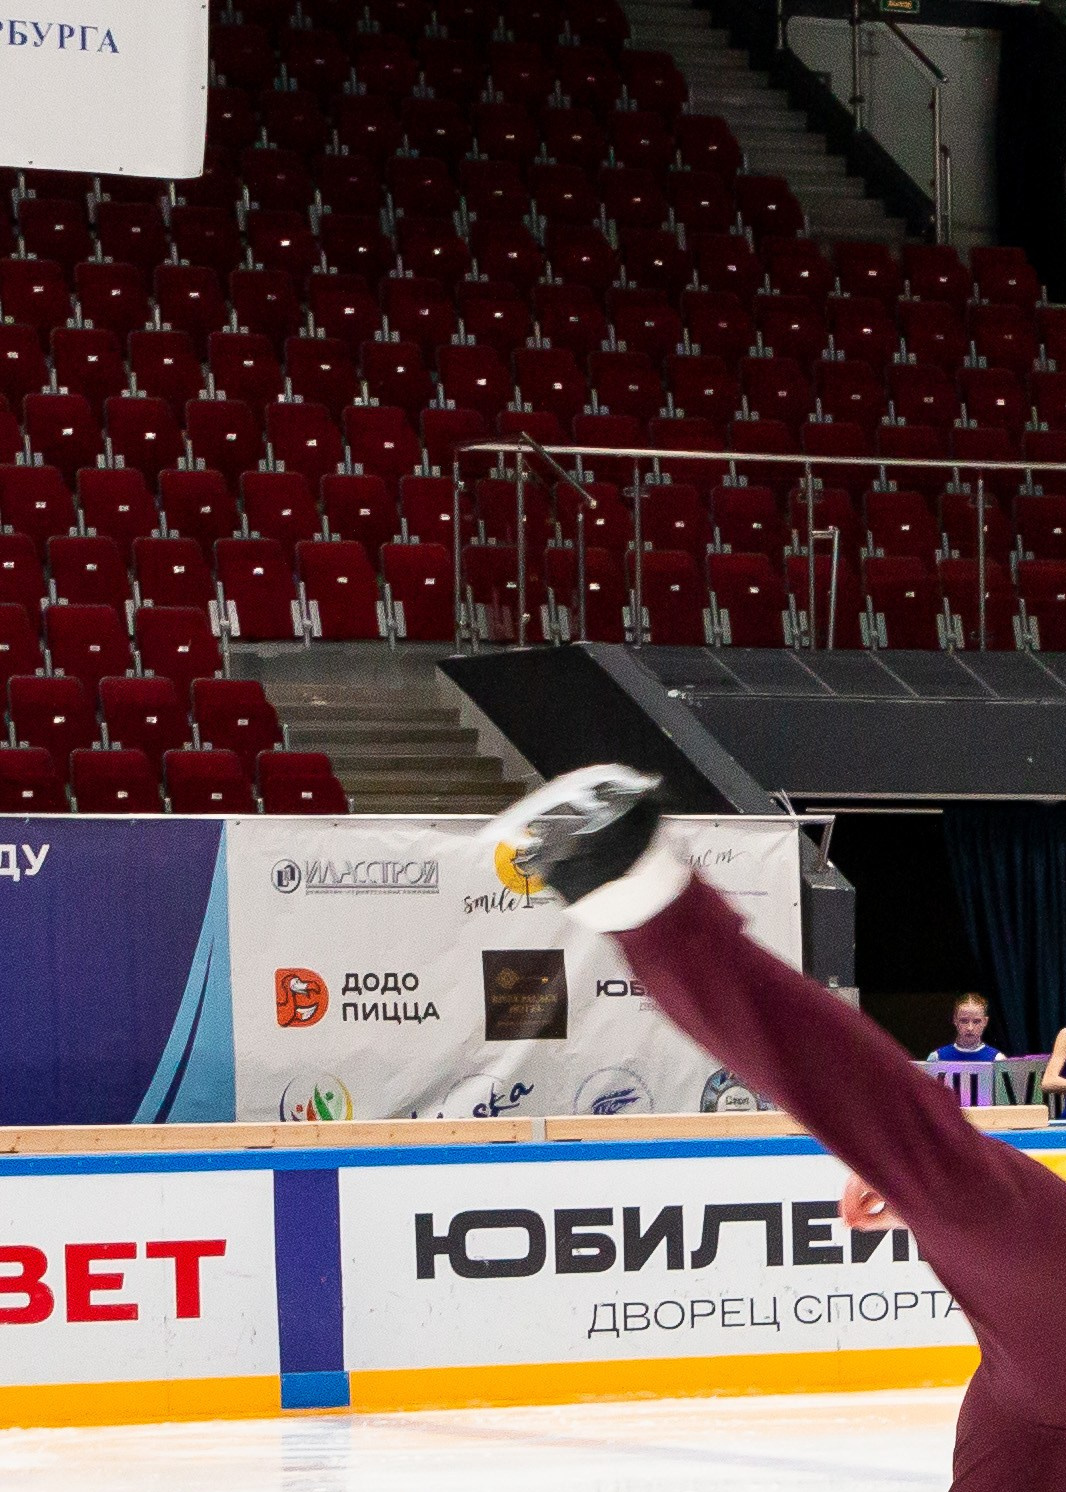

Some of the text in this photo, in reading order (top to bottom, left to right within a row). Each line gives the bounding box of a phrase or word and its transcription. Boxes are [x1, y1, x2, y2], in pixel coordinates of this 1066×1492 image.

[0, 19, 120, 54] БУРГА
[462, 886, 523, 914] smile
[342, 972, 419, 996] ДОДО
[342, 1001, 440, 1024] ПИЦЦА
[414, 1199, 929, 1280] ЮБИЛЕ
[0, 1238, 227, 1324] BET
[587, 1296, 781, 1340] ДВОРЕЦ
